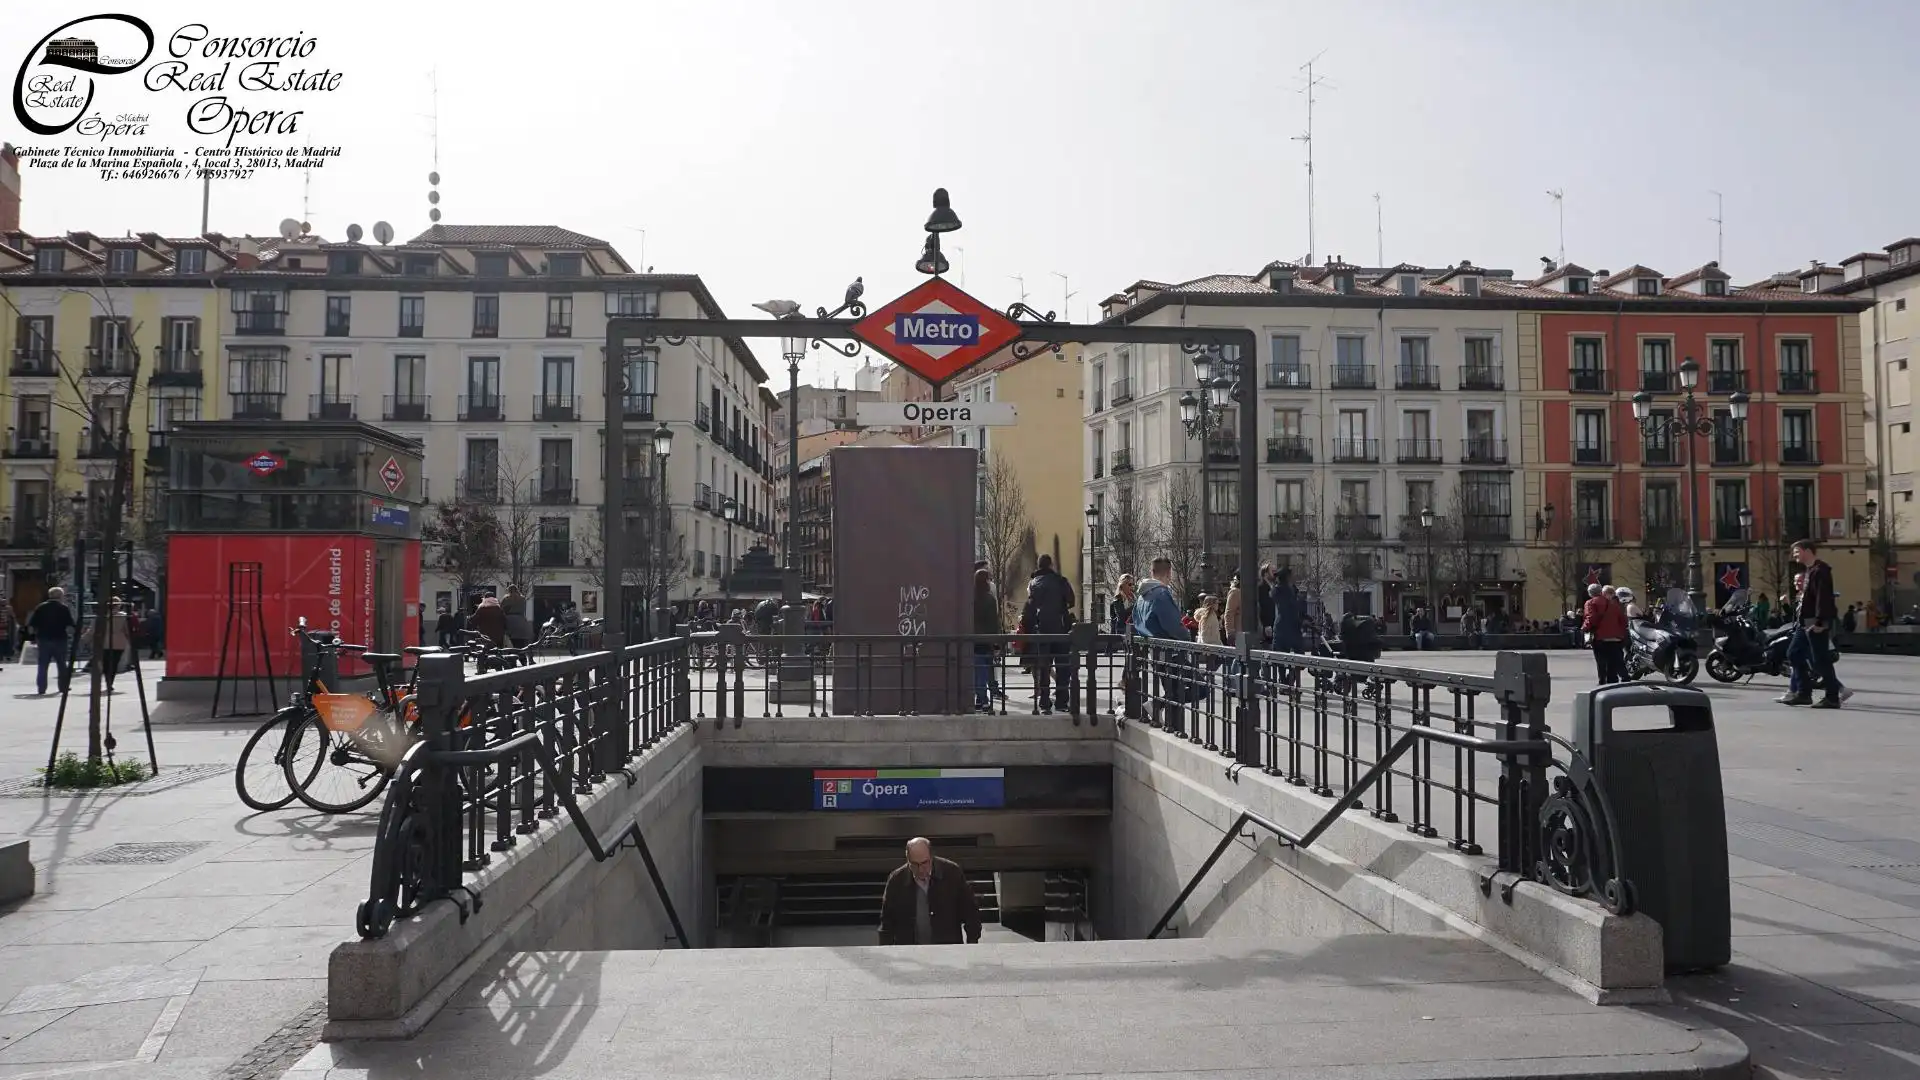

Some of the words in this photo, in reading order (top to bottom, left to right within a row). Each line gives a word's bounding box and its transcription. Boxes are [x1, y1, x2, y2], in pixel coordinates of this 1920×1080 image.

[903, 318, 972, 339] Metro
[903, 403, 972, 424] Opera
[253, 460, 275, 468] Metro
[328, 548, 342, 595] Madrid
[328, 599, 341, 616] de
[826, 781, 834, 791] 2
[862, 779, 908, 798] Ópera
[825, 796, 835, 806] R
